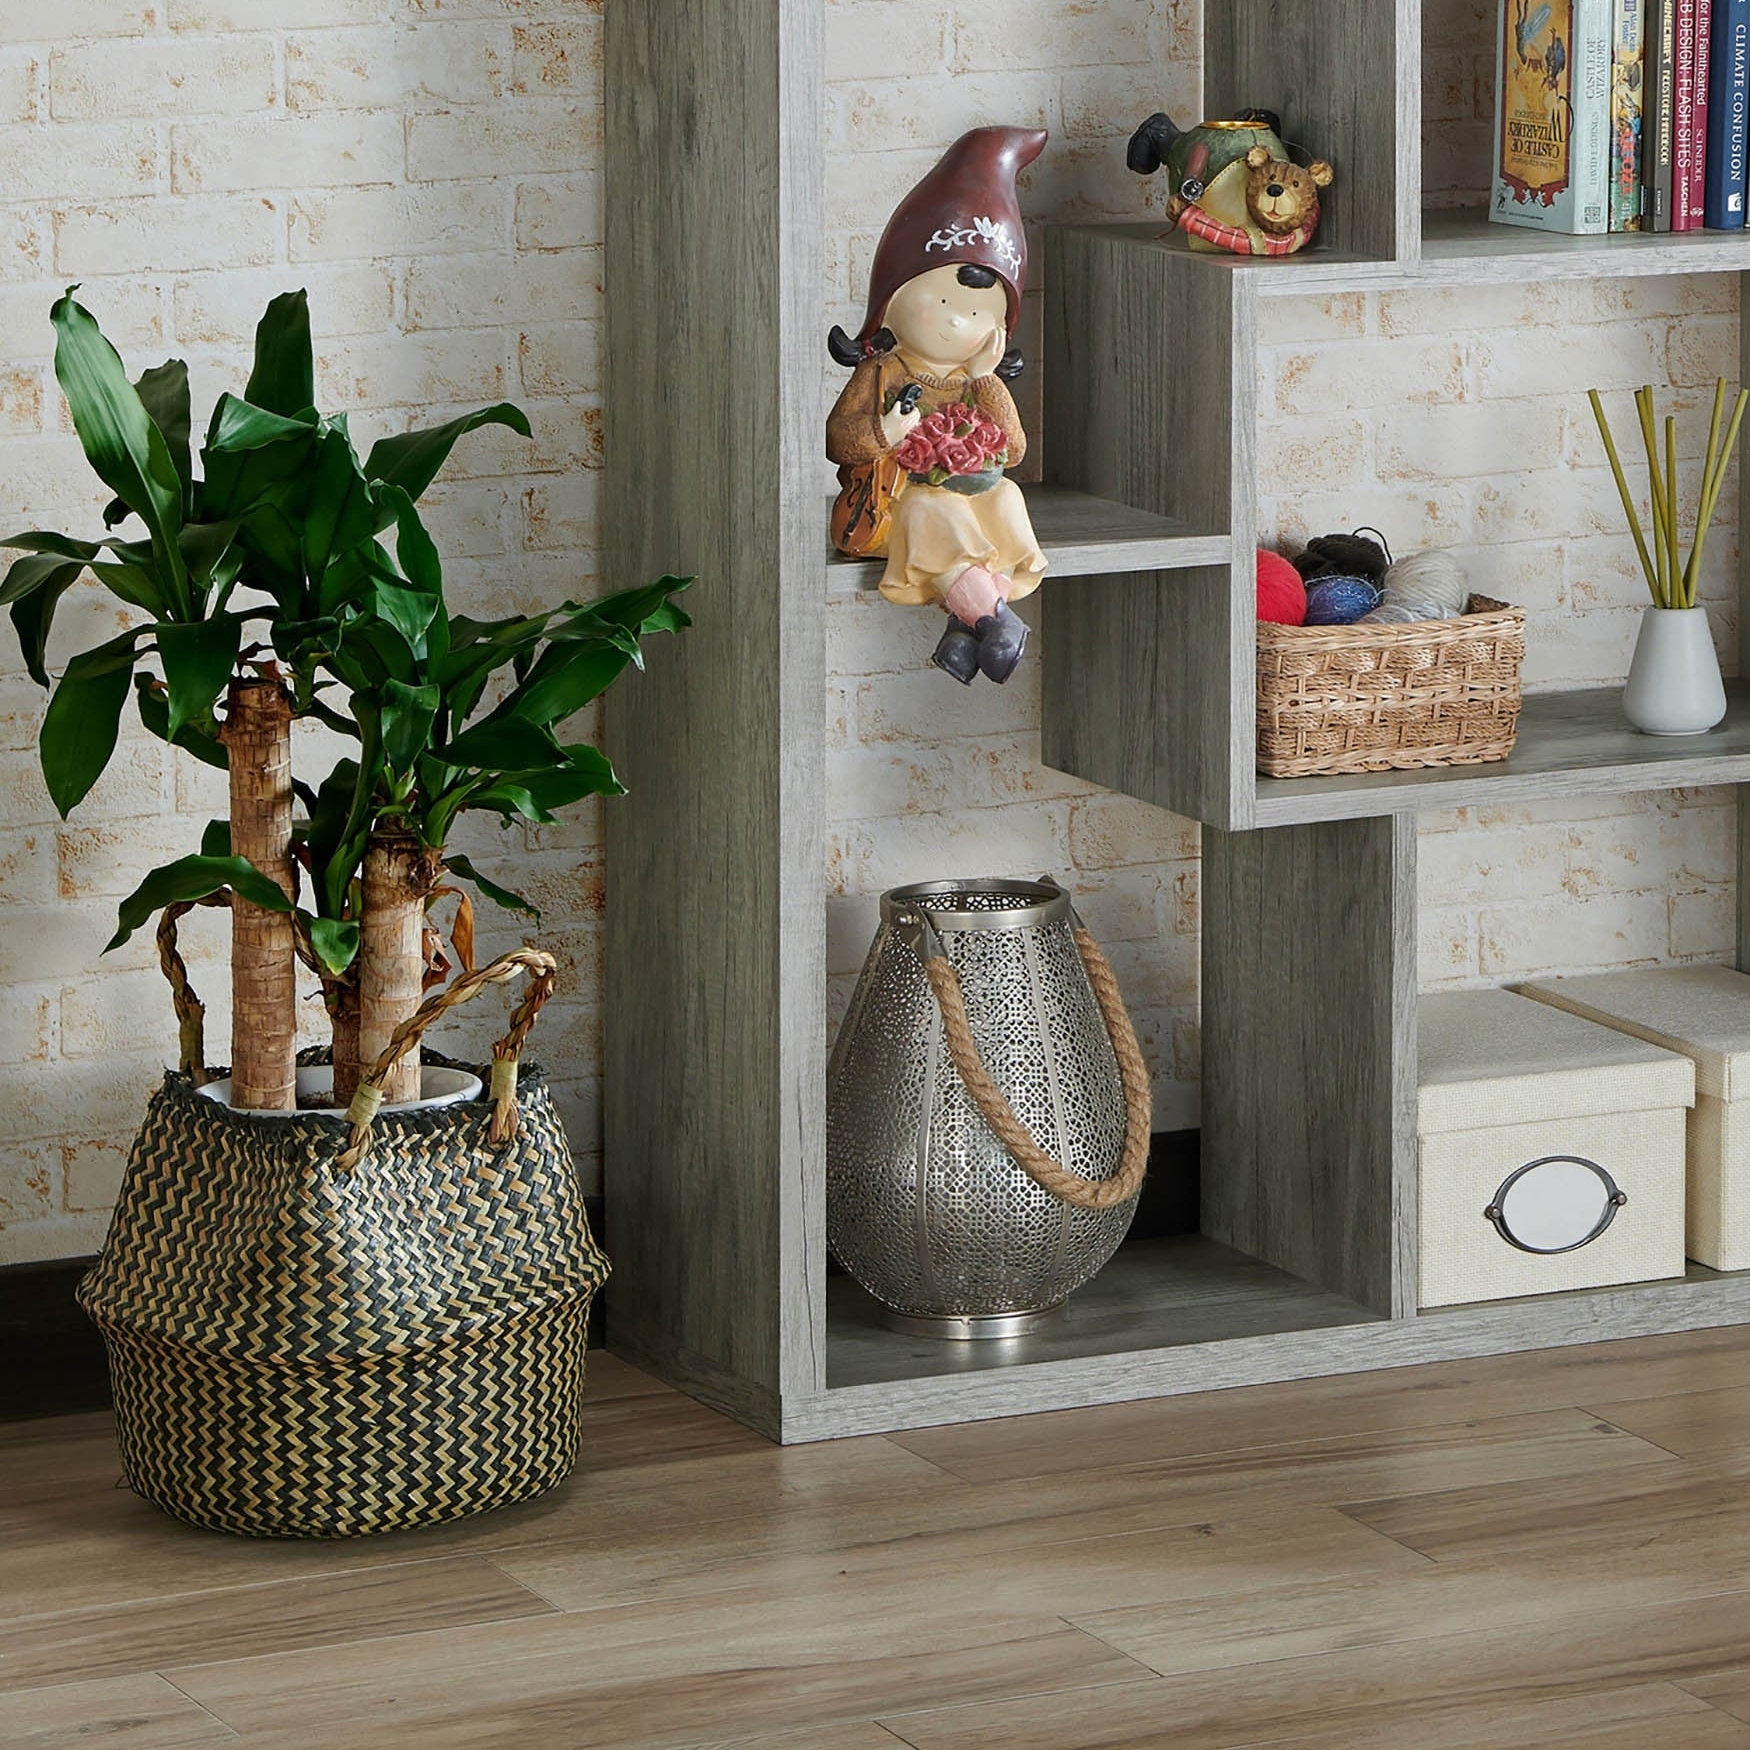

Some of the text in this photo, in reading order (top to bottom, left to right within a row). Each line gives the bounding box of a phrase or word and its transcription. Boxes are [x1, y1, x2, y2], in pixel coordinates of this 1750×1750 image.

[1700, 0, 1710, 14] for
[1700, 17, 1710, 35] the
[1622, 20, 1630, 44] Foster
[1679, 18, 1693, 74] DESIGN:
[1697, 38, 1709, 105] Fainthearted
[1678, 78, 1692, 124] FLASH
[1730, 24, 1746, 181] CLIMATE CONFUSION
[1524, 140, 1560, 159] CASTLE
[1678, 128, 1691, 169] SITES
[1680, 175, 1689, 217] TASCHEN
